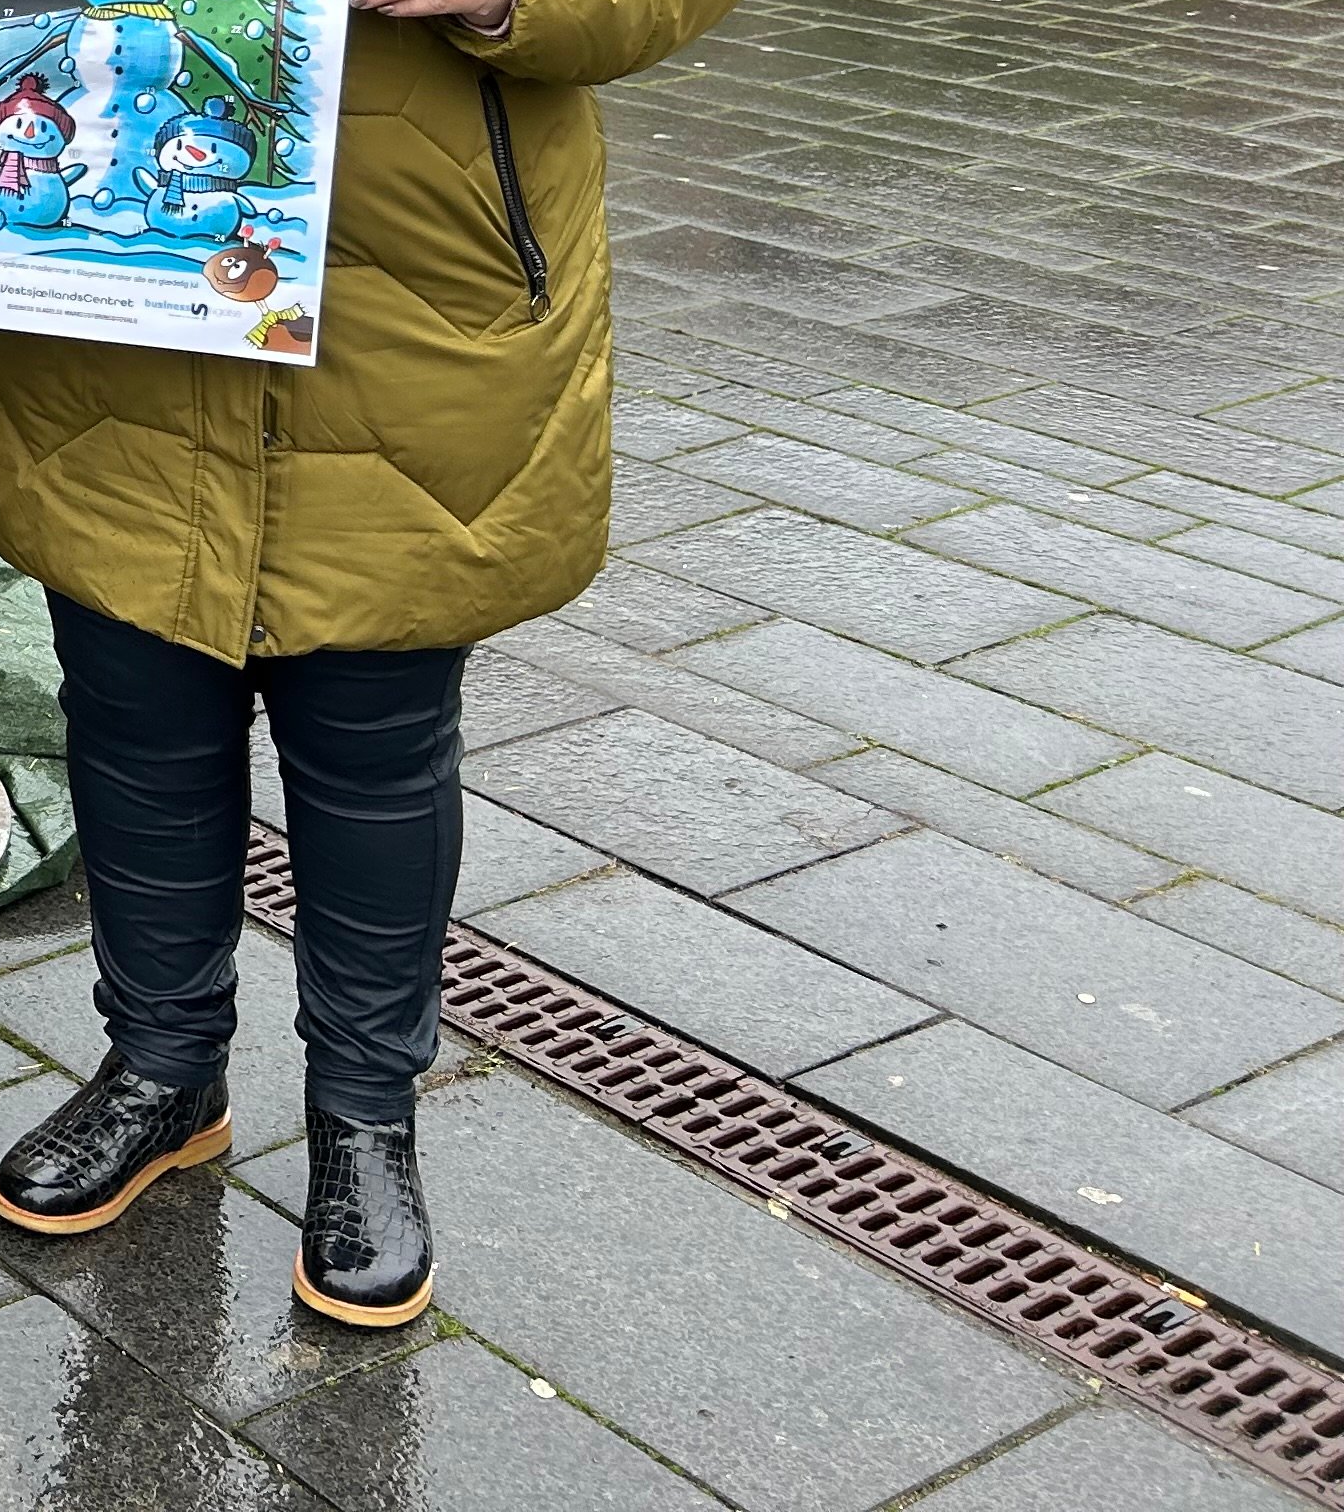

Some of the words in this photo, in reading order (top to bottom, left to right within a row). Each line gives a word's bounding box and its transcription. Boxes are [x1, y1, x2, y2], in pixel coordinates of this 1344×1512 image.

[189, 281, 199, 291] jul
[0, 281, 135, 311] VestsjællandsCentret
[144, 297, 191, 313] business
